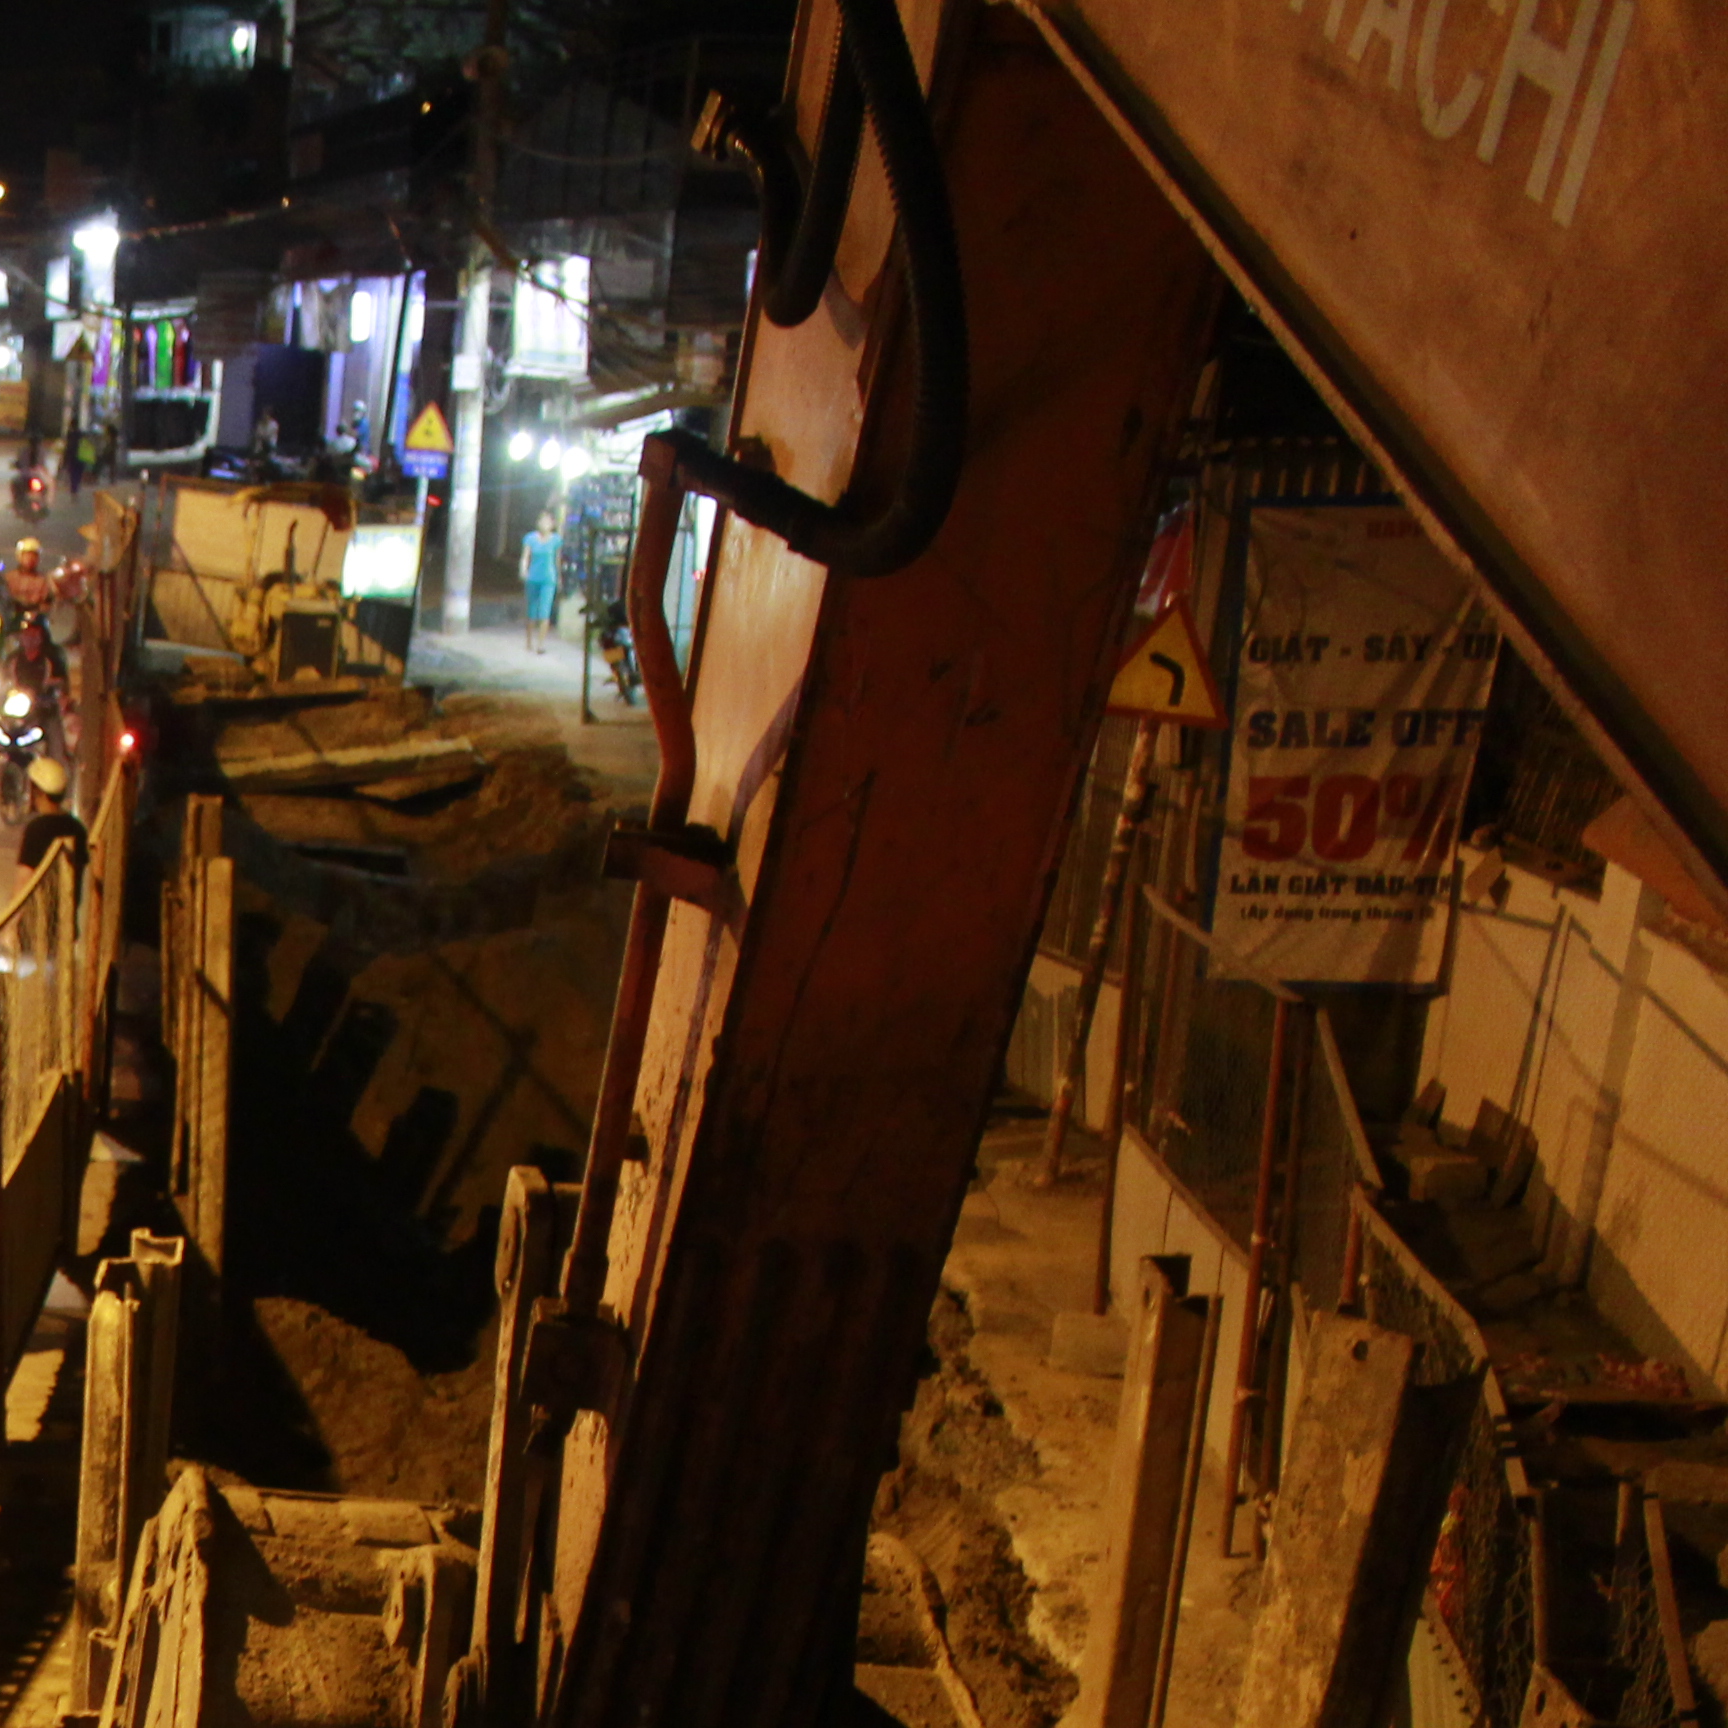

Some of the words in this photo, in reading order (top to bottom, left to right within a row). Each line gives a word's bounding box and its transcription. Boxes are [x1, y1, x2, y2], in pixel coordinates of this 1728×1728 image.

[1291, 0, 1634, 228] ACHI
[1247, 710, 1376, 748] SALE
[1391, 708, 1486, 748] OFF
[1241, 773, 1459, 863] 50%
